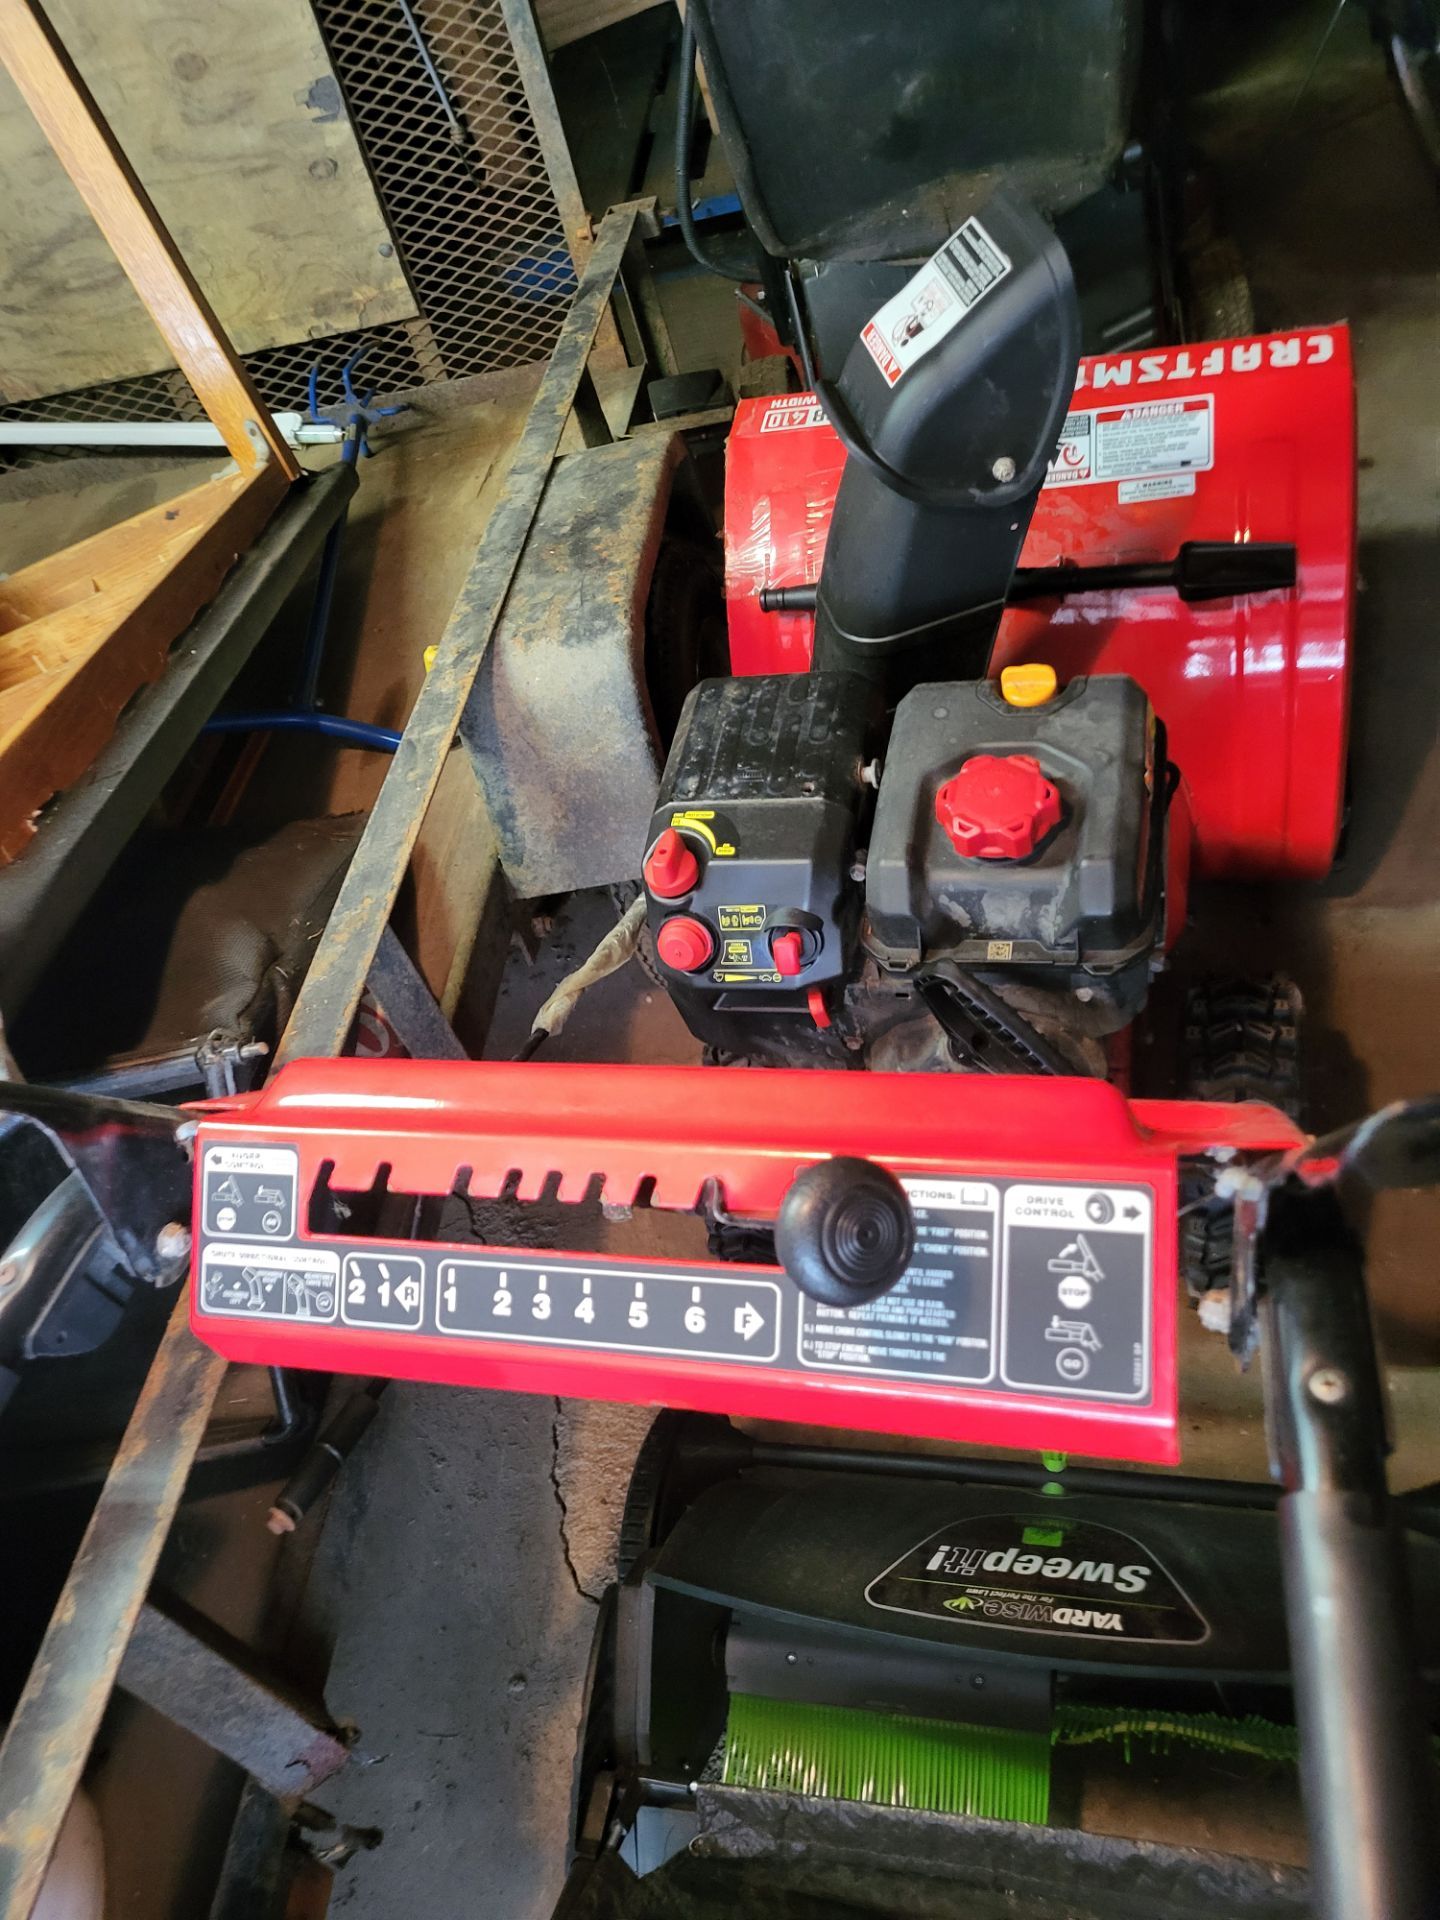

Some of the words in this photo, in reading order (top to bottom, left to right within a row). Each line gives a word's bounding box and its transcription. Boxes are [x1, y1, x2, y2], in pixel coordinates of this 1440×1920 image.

[1075, 334, 1334, 391] CRAFTSM
[770, 395, 817, 409] WIDTH
[1133, 402, 1184, 419] DANGER
[768, 411, 806, 428] 410
[909, 1190, 957, 1200] CTIONS:
[1026, 1195, 1065, 1206] DRIVE
[1015, 1207, 1076, 1219] CONTROL
[348, 1278, 366, 1305] 2
[377, 1281, 391, 1307] 1
[1060, 1287, 1088, 1297] STOP
[443, 1286, 457, 1312] 1
[492, 1290, 512, 1317] 2
[532, 1292, 551, 1320] 3
[574, 1296, 595, 1324] 4
[628, 1301, 649, 1328] 5
[684, 1305, 706, 1334] 6
[1063, 1358, 1082, 1369] GO
[966, 1587, 989, 1597] Lawn
[990, 1589, 1021, 1600] Perfect
[1022, 1593, 1038, 1602] The
